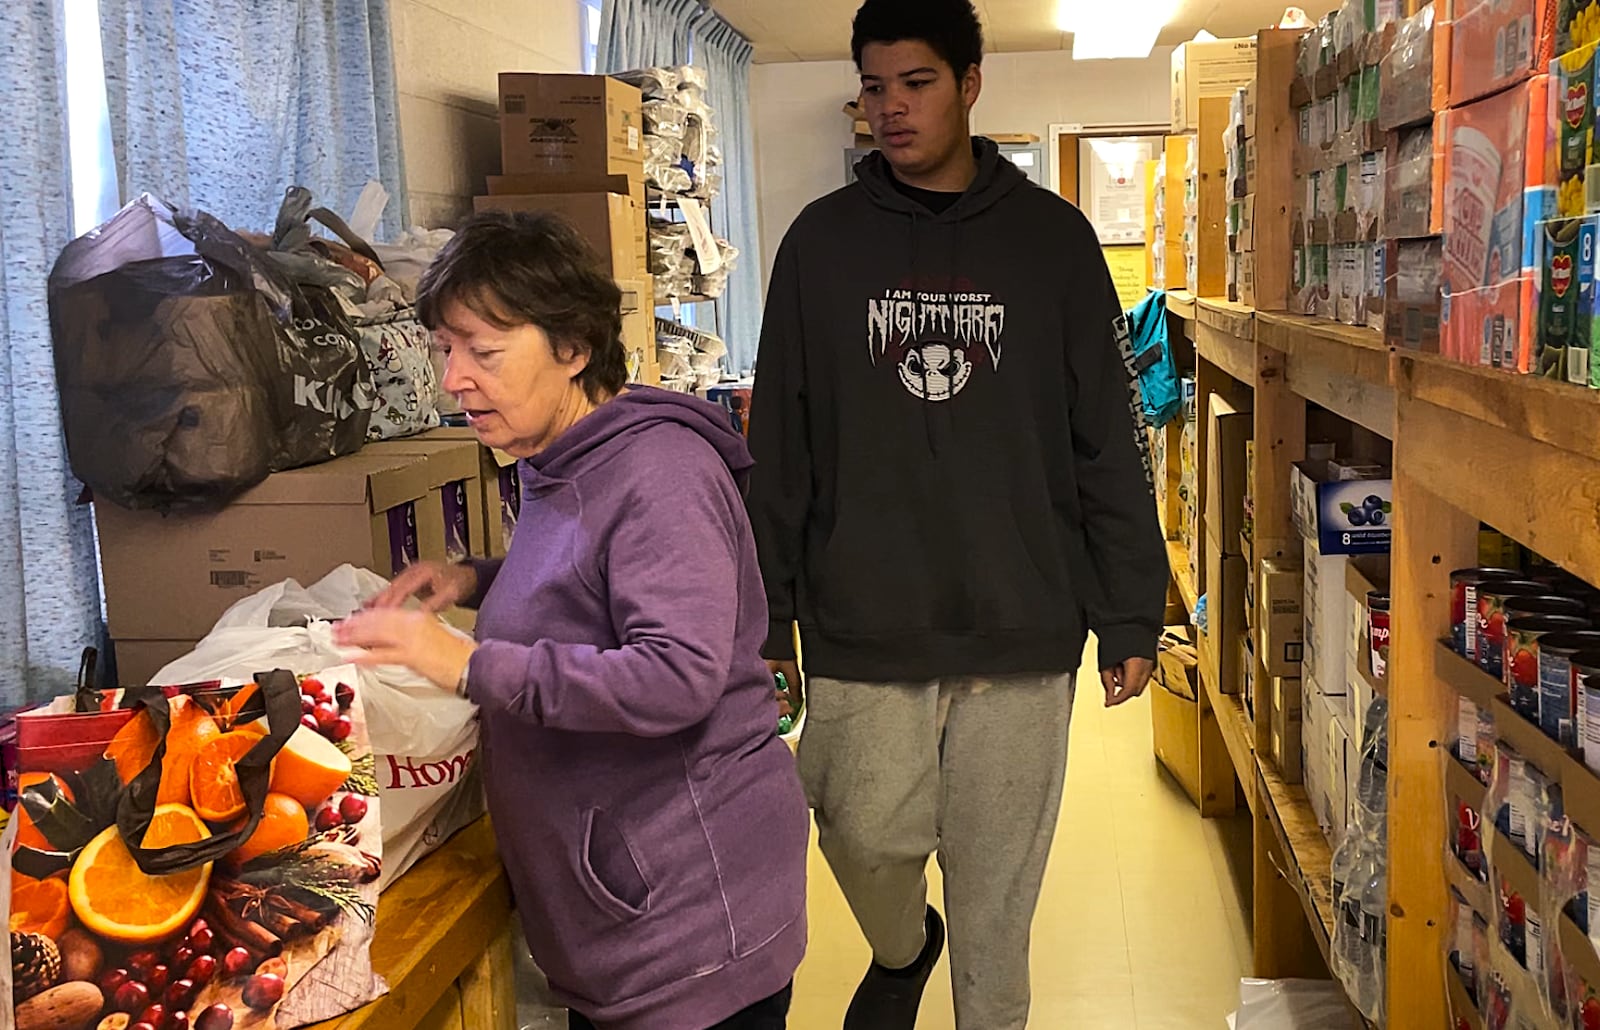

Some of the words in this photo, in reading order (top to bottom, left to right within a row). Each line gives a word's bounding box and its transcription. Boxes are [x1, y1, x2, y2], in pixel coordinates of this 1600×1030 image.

[1583, 233, 1592, 261] 8
[886, 289, 890, 298] I
[893, 290, 911, 299] AM
[1342, 532, 1351, 545] 8
